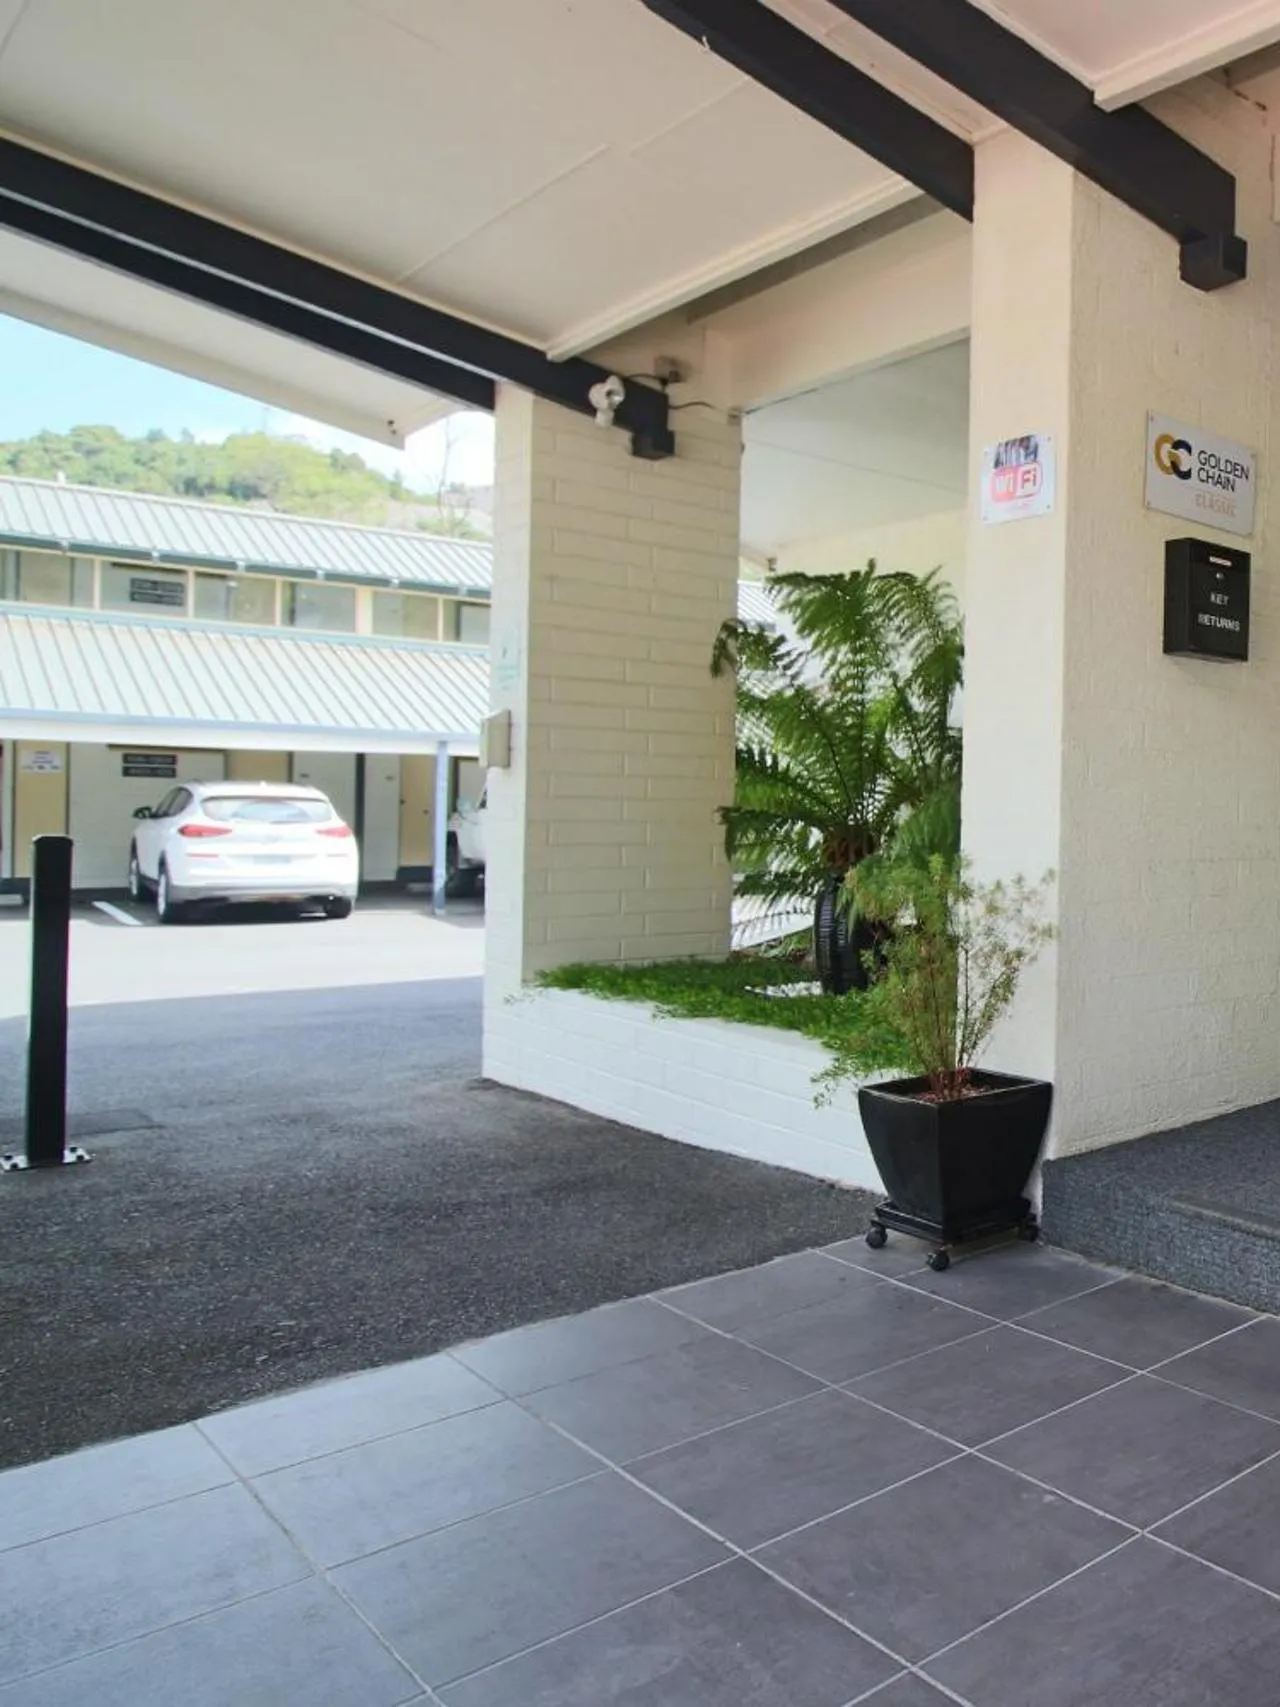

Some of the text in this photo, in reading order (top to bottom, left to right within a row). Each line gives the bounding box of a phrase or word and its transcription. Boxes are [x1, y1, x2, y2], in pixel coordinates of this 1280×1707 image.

[1197, 450, 1250, 481] GOLDEN
[1197, 467, 1236, 492] CHAIN
[1210, 591, 1230, 605] KEY
[1198, 612, 1240, 632] RETURNS
